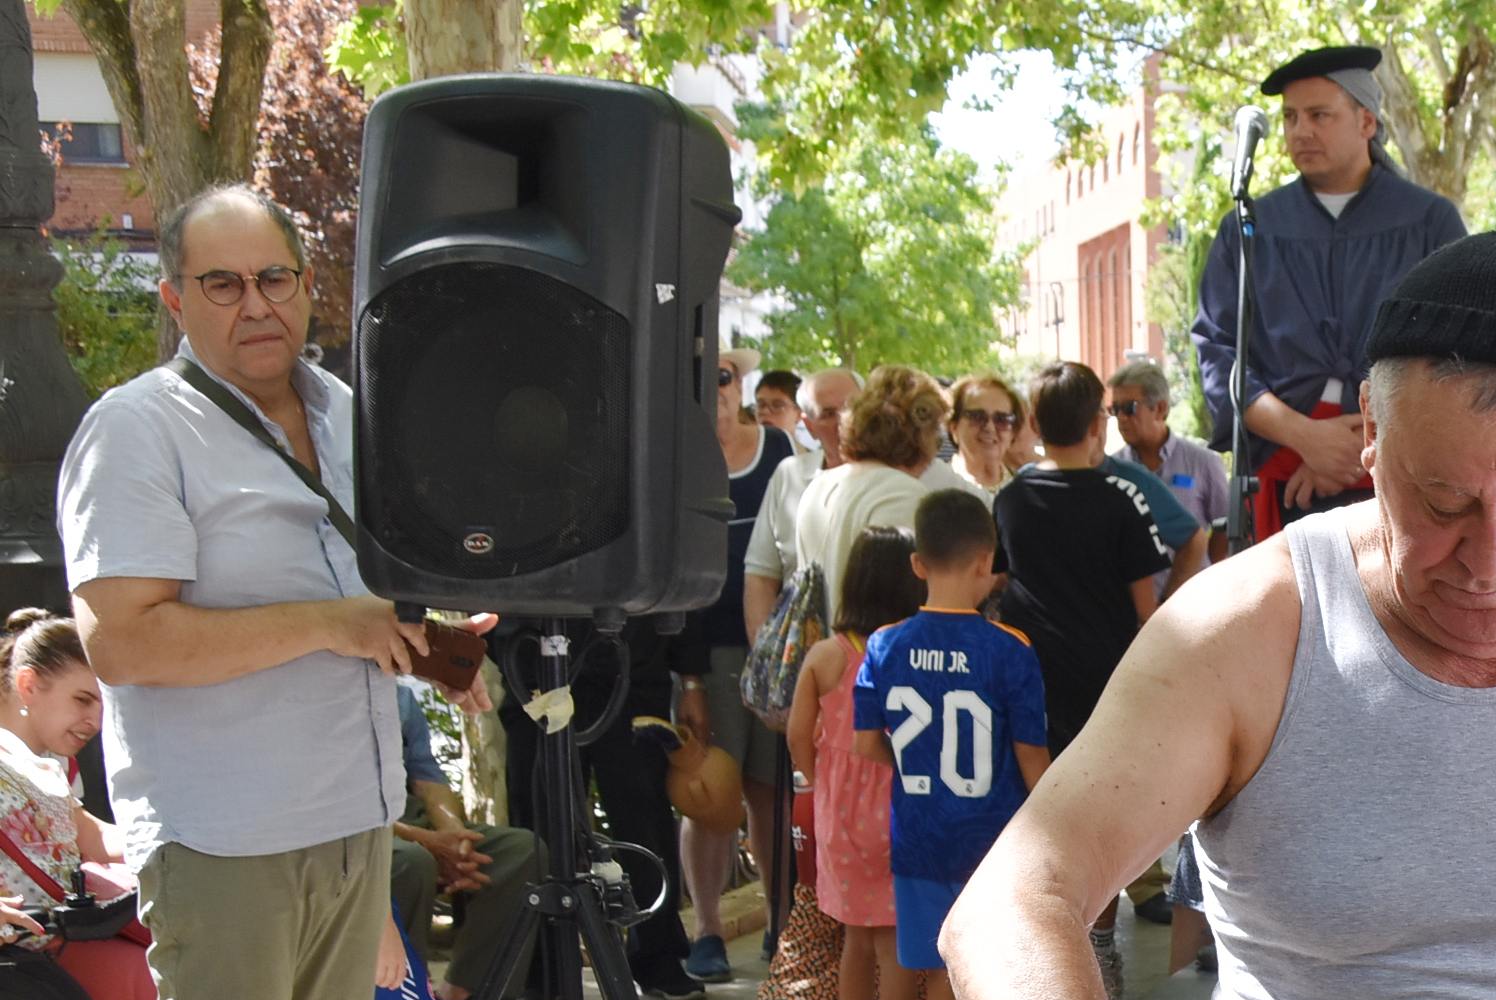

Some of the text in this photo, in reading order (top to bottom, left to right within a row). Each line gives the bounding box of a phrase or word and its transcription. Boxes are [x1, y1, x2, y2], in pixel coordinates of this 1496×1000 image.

[909, 648, 970, 673] VINI JR.
[886, 686, 993, 798] 20
